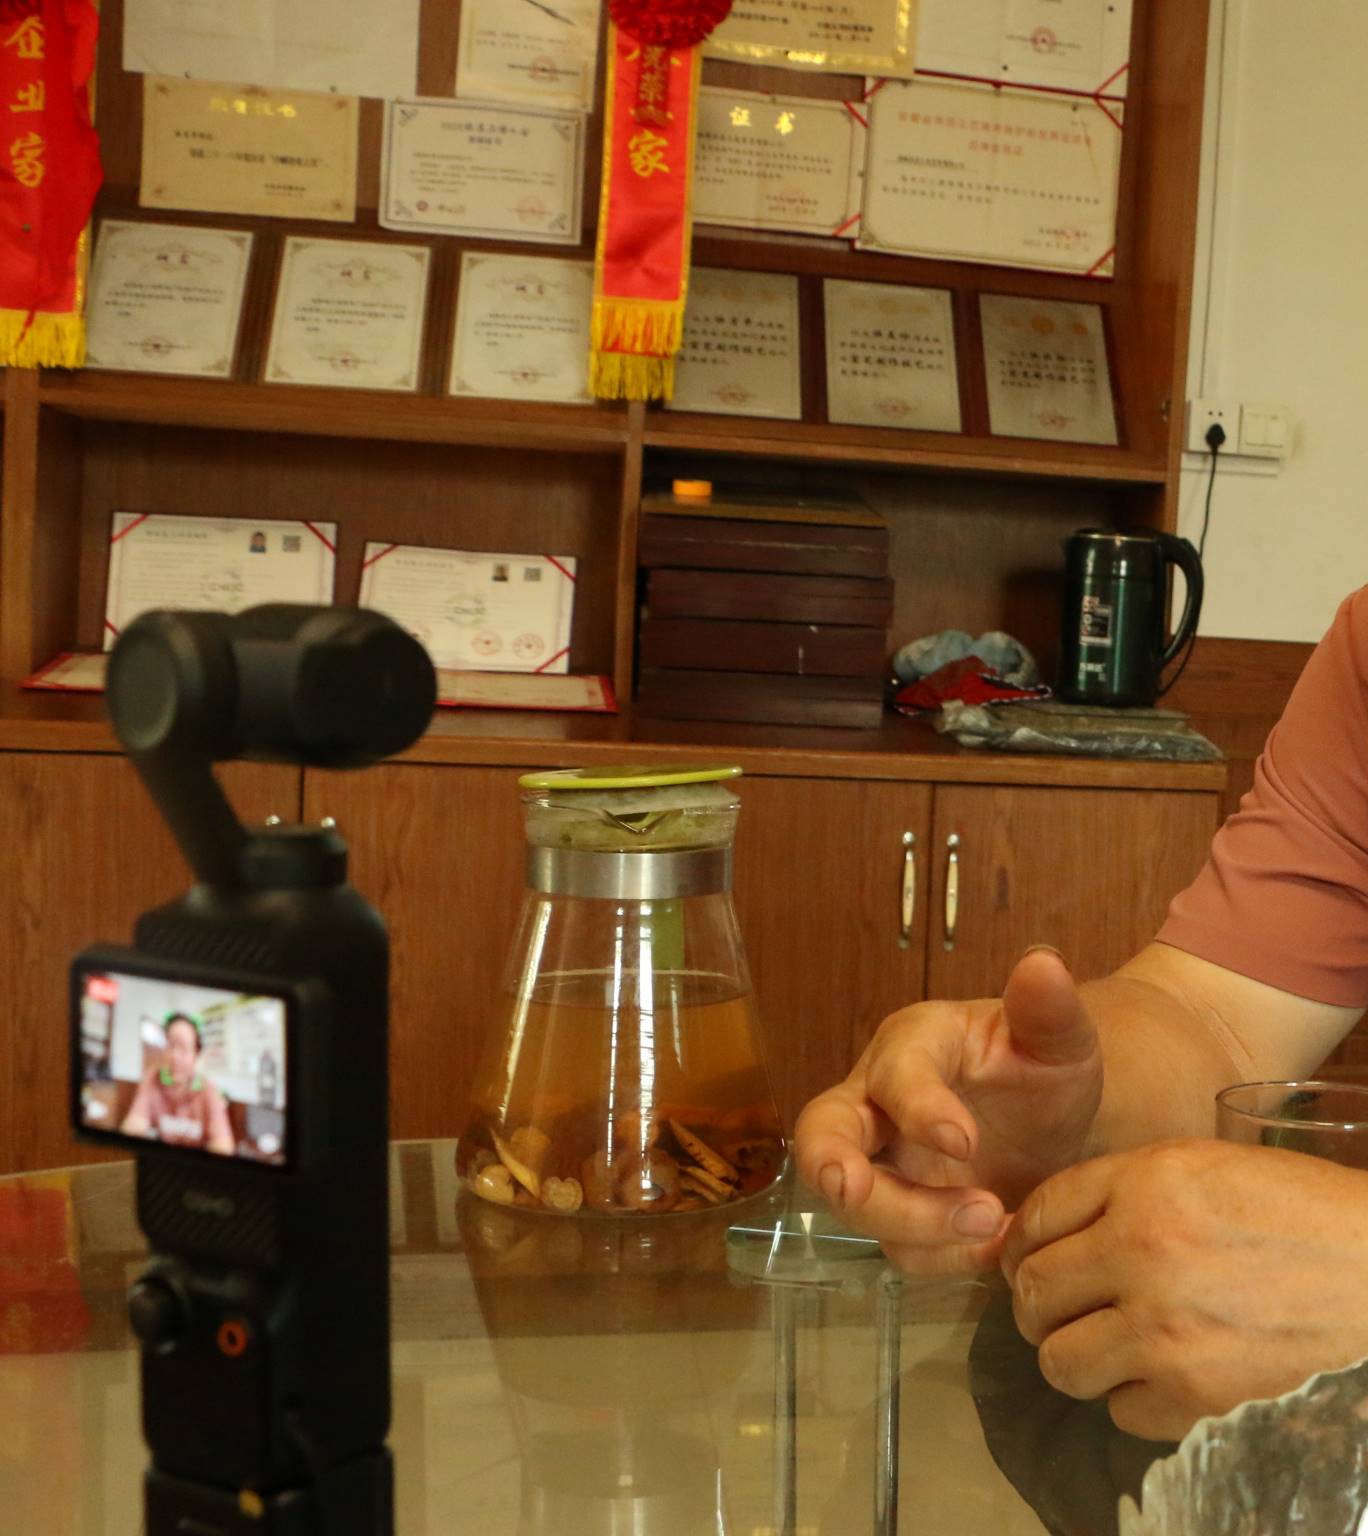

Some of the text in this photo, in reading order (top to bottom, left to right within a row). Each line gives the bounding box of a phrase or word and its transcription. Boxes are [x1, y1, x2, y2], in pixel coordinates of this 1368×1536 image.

[4, 14, 46, 188] 企业家
[729, 106, 796, 136] 证书
